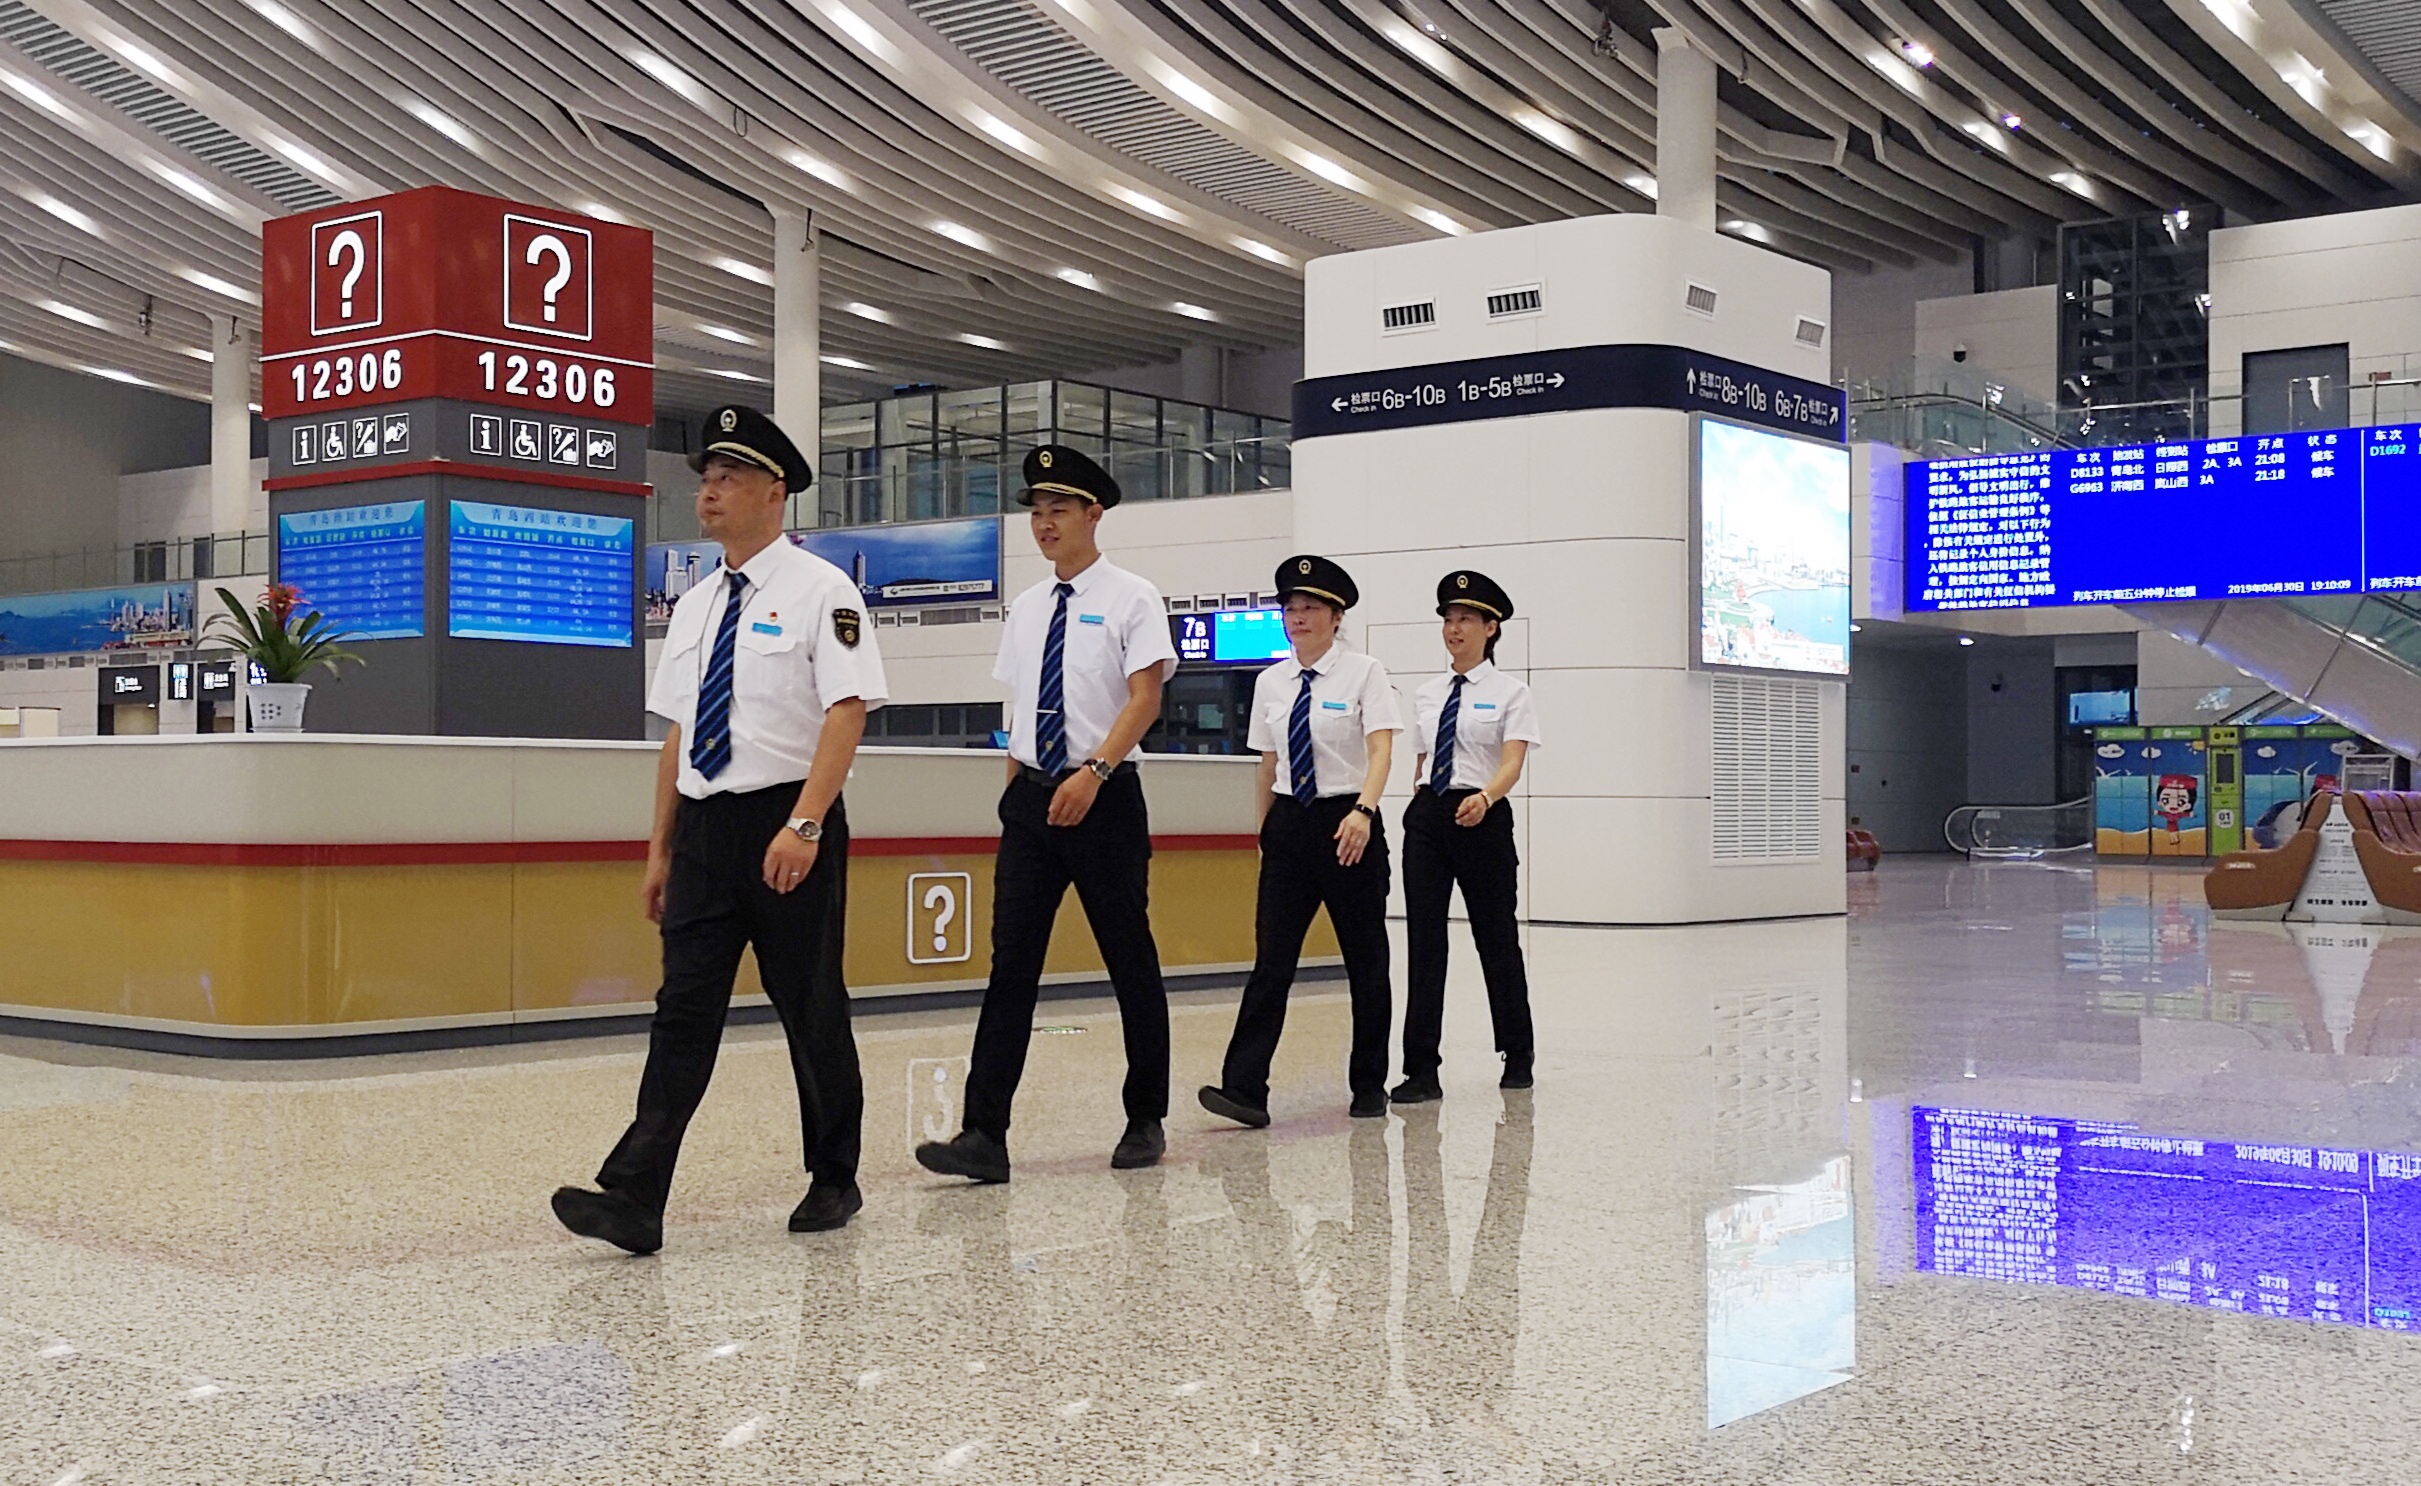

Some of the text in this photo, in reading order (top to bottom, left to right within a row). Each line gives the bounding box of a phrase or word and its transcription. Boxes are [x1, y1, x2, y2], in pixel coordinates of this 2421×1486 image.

[291, 347, 403, 402] 12306
[477, 351, 616, 407] 12306
[1350, 372, 1544, 410] 检票口 6B-10B 1B-5B 检票口
[1721, 376, 1767, 412] 8B-10B
[1775, 390, 1808, 422] 6B-7B
[1183, 616, 1207, 638] 7B
